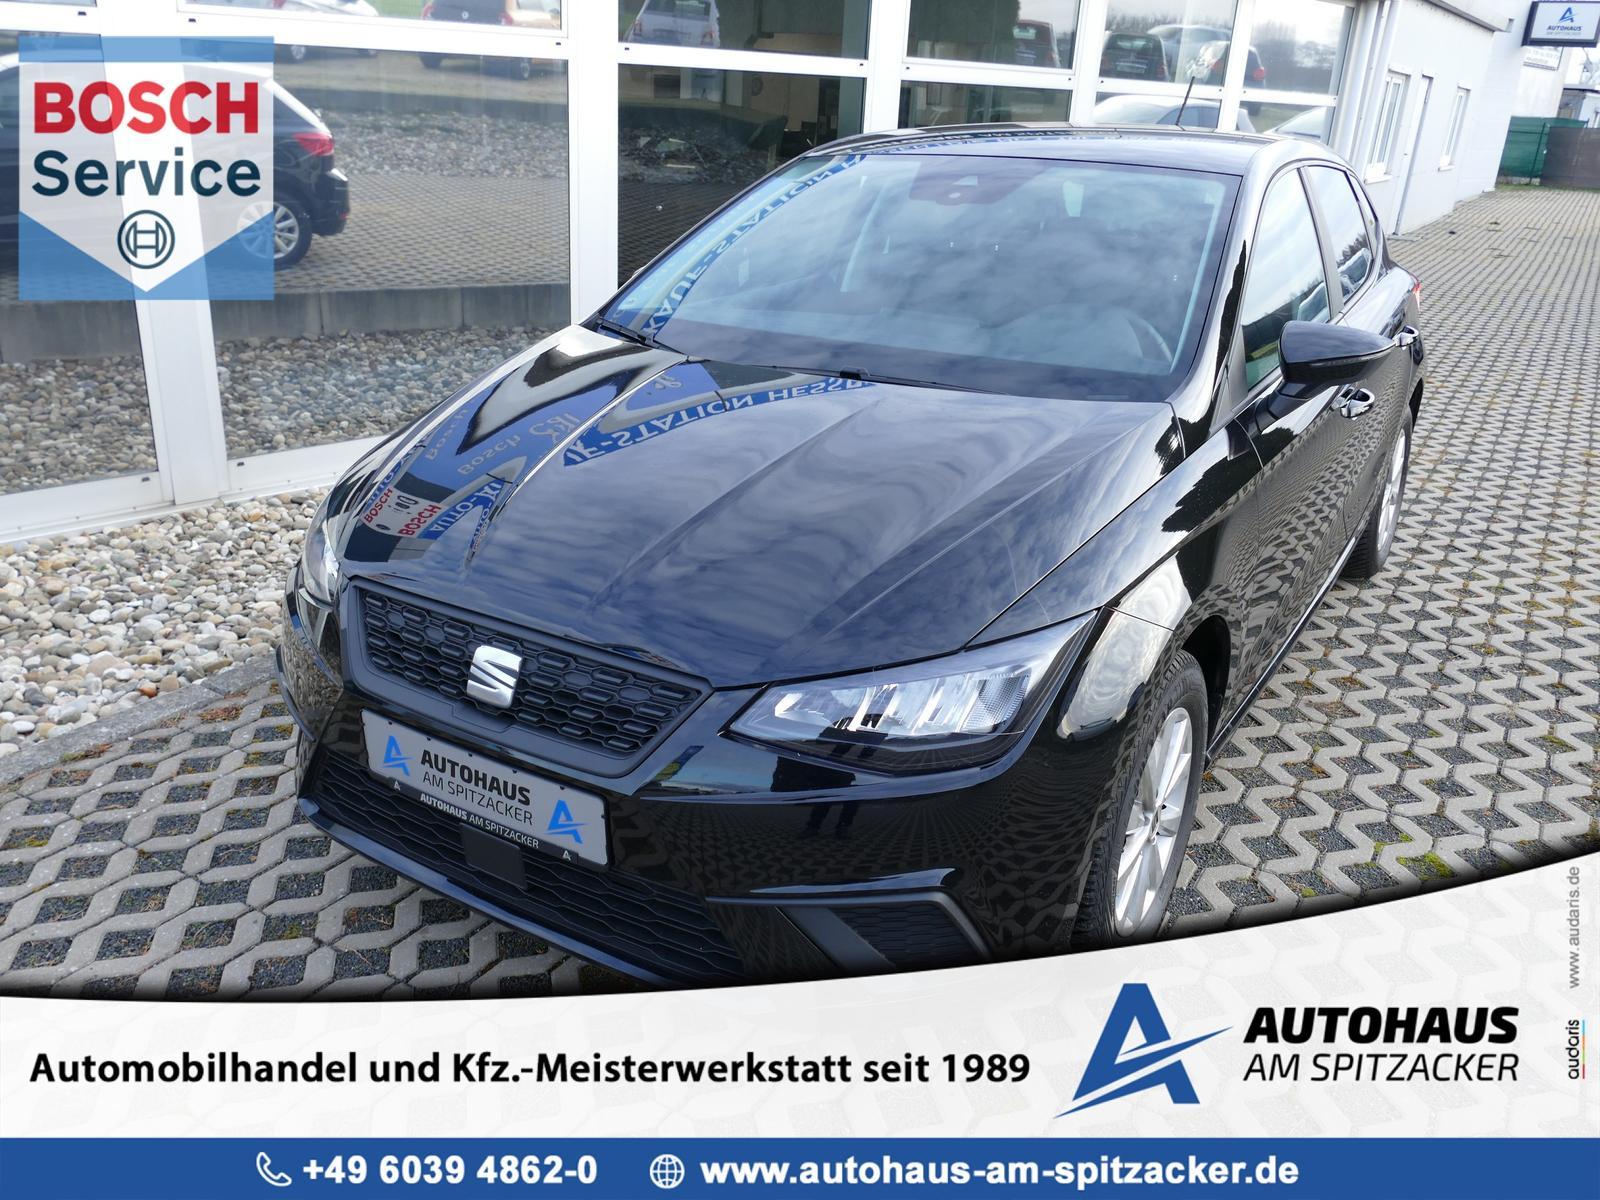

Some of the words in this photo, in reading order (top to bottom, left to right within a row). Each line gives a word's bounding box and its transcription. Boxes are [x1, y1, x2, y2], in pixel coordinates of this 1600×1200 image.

[420, 749, 531, 806] AUTOHAUS
[423, 771, 444, 793] AM
[447, 781, 534, 826] SPITZACKER
[420, 793, 468, 821] AUTOHAUS
[468, 813, 484, 828] AM
[485, 819, 540, 849] SPITZACKER
